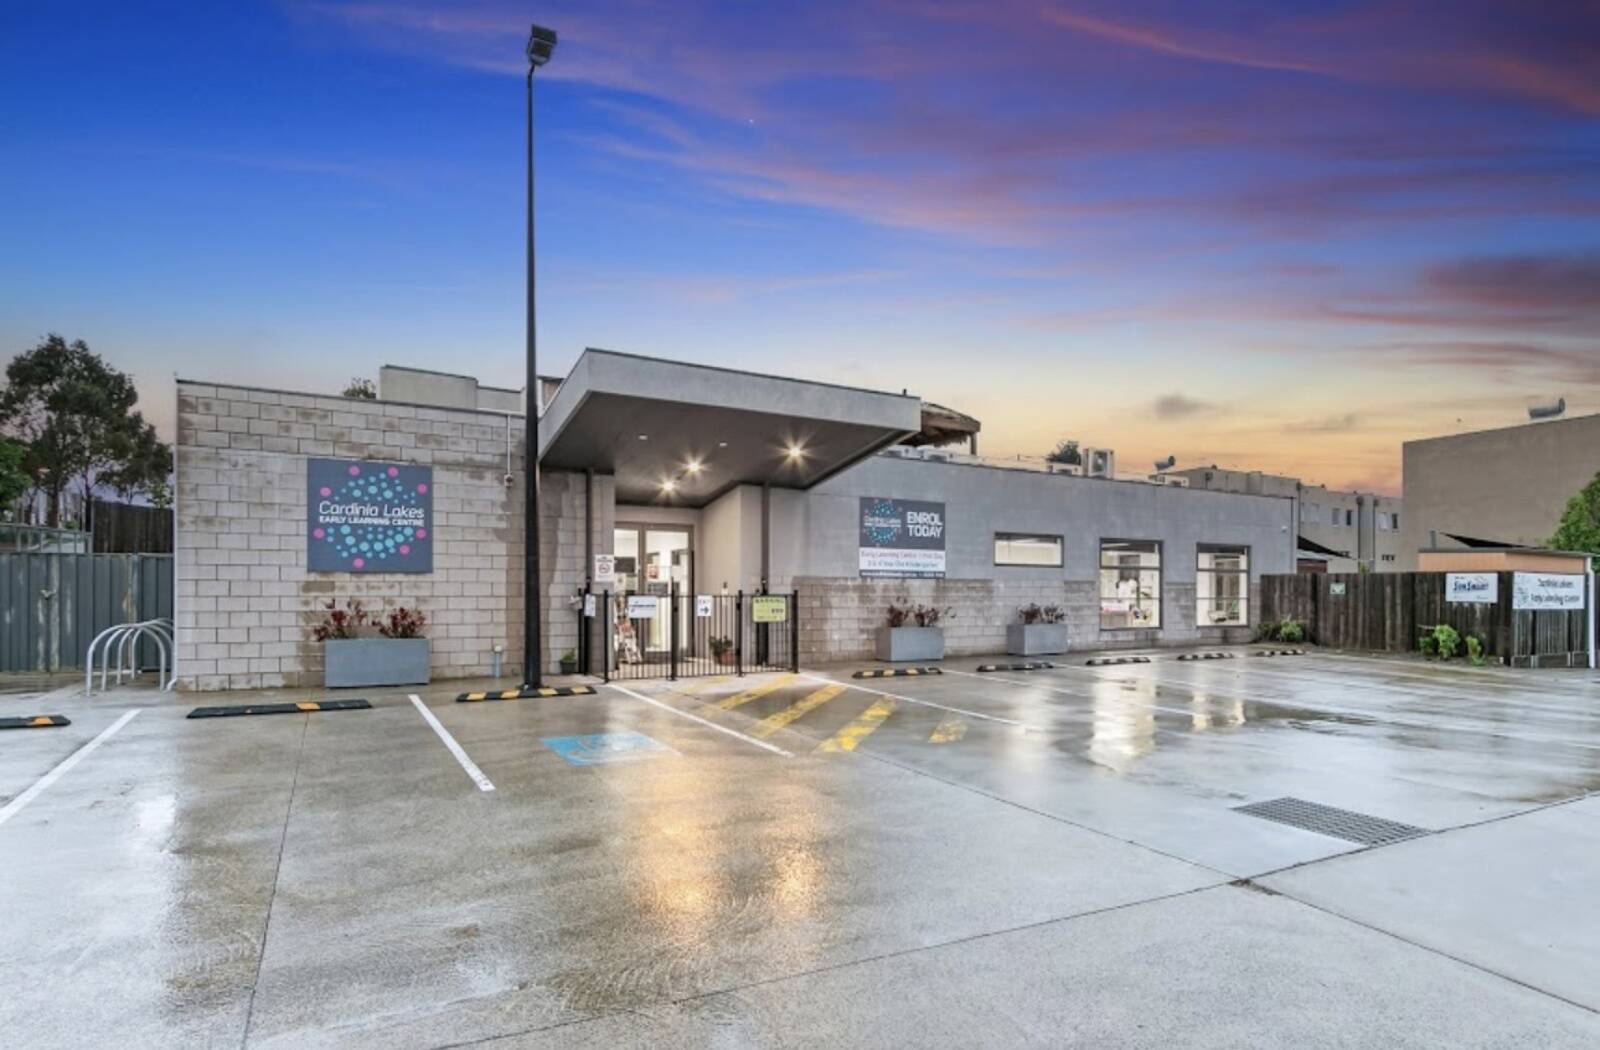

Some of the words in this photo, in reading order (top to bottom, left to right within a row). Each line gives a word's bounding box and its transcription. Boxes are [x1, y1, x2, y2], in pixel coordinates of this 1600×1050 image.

[319, 500, 378, 516] Cardinia
[383, 503, 425, 518] Lakes
[319, 515, 347, 524] EARLY
[348, 516, 390, 525] LEARNING
[391, 518, 425, 527] CENTRE
[906, 511, 943, 525] ENROL
[906, 525, 943, 538] TODAY
